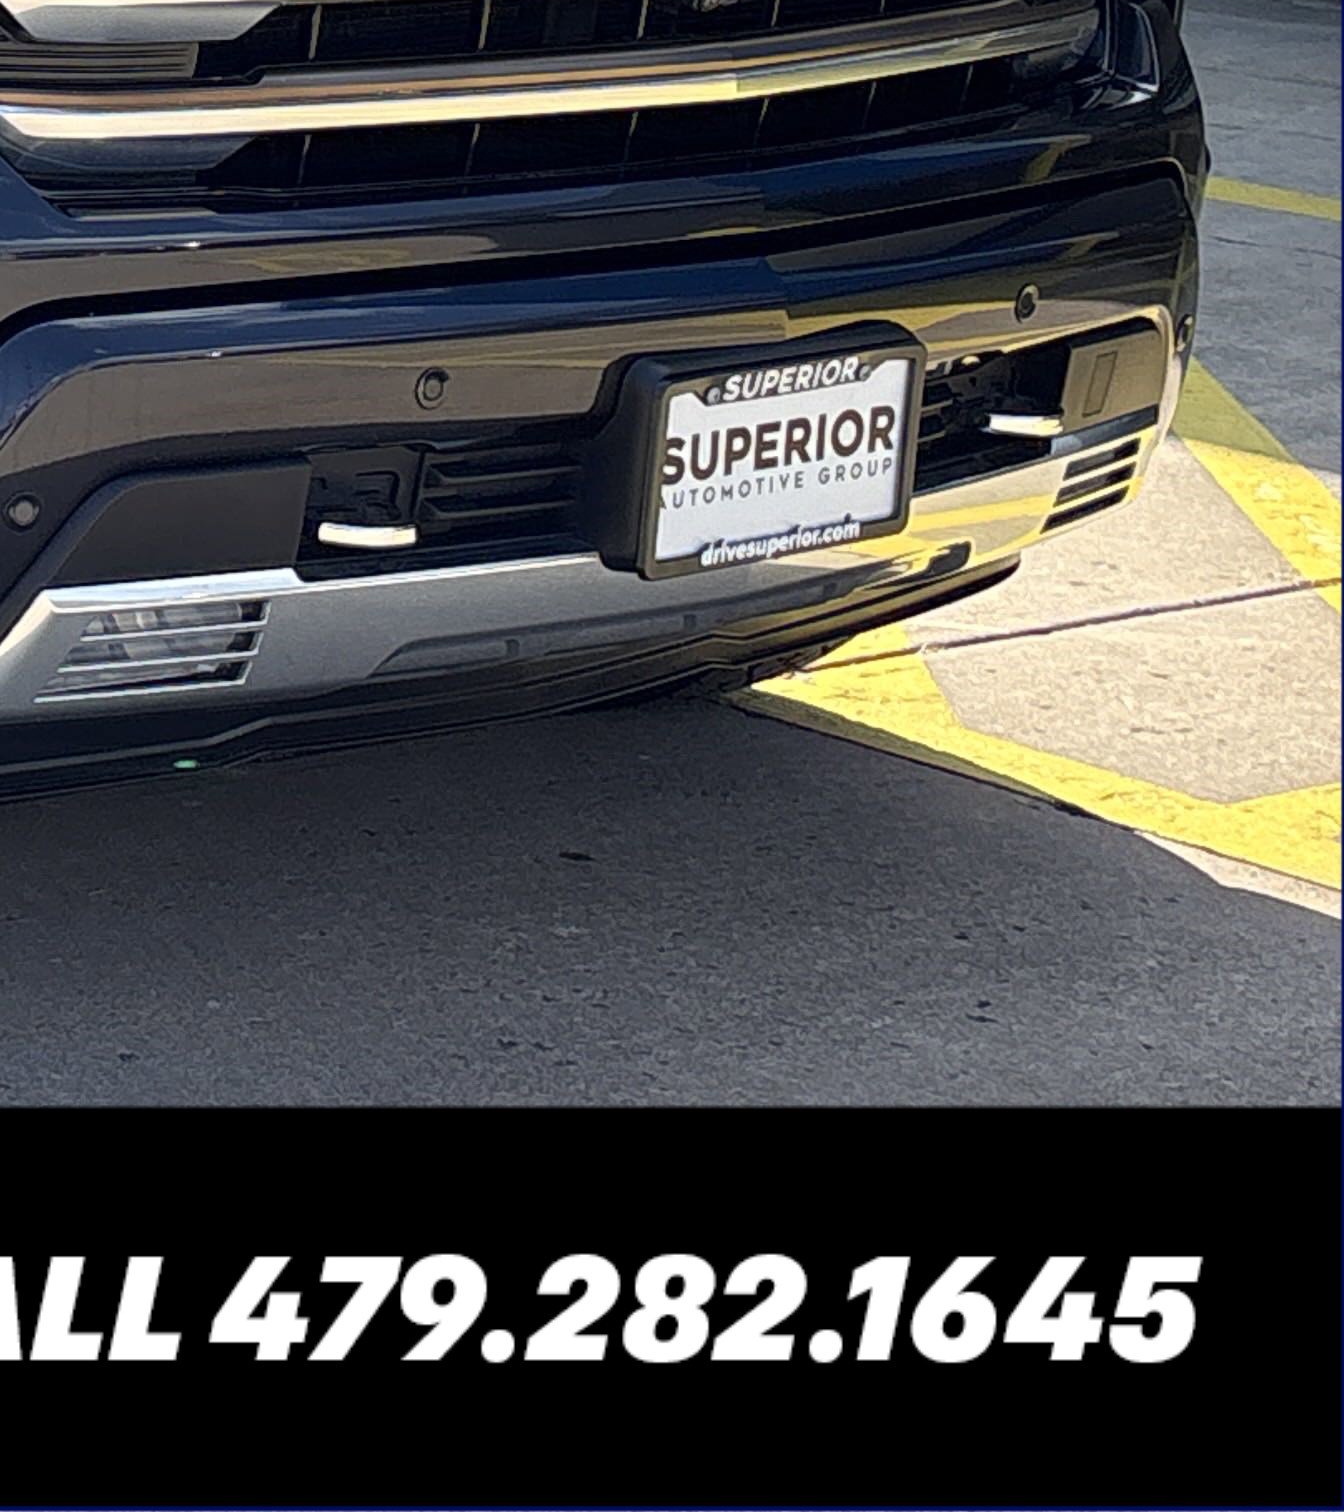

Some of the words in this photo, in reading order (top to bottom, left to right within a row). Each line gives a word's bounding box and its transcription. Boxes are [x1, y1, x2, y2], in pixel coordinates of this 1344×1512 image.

[723, 355, 860, 402] SUPERIOR
[661, 405, 896, 486] SUPERIOR
[818, 456, 894, 486] GROUP
[700, 518, 861, 568] drivesuperior.com
